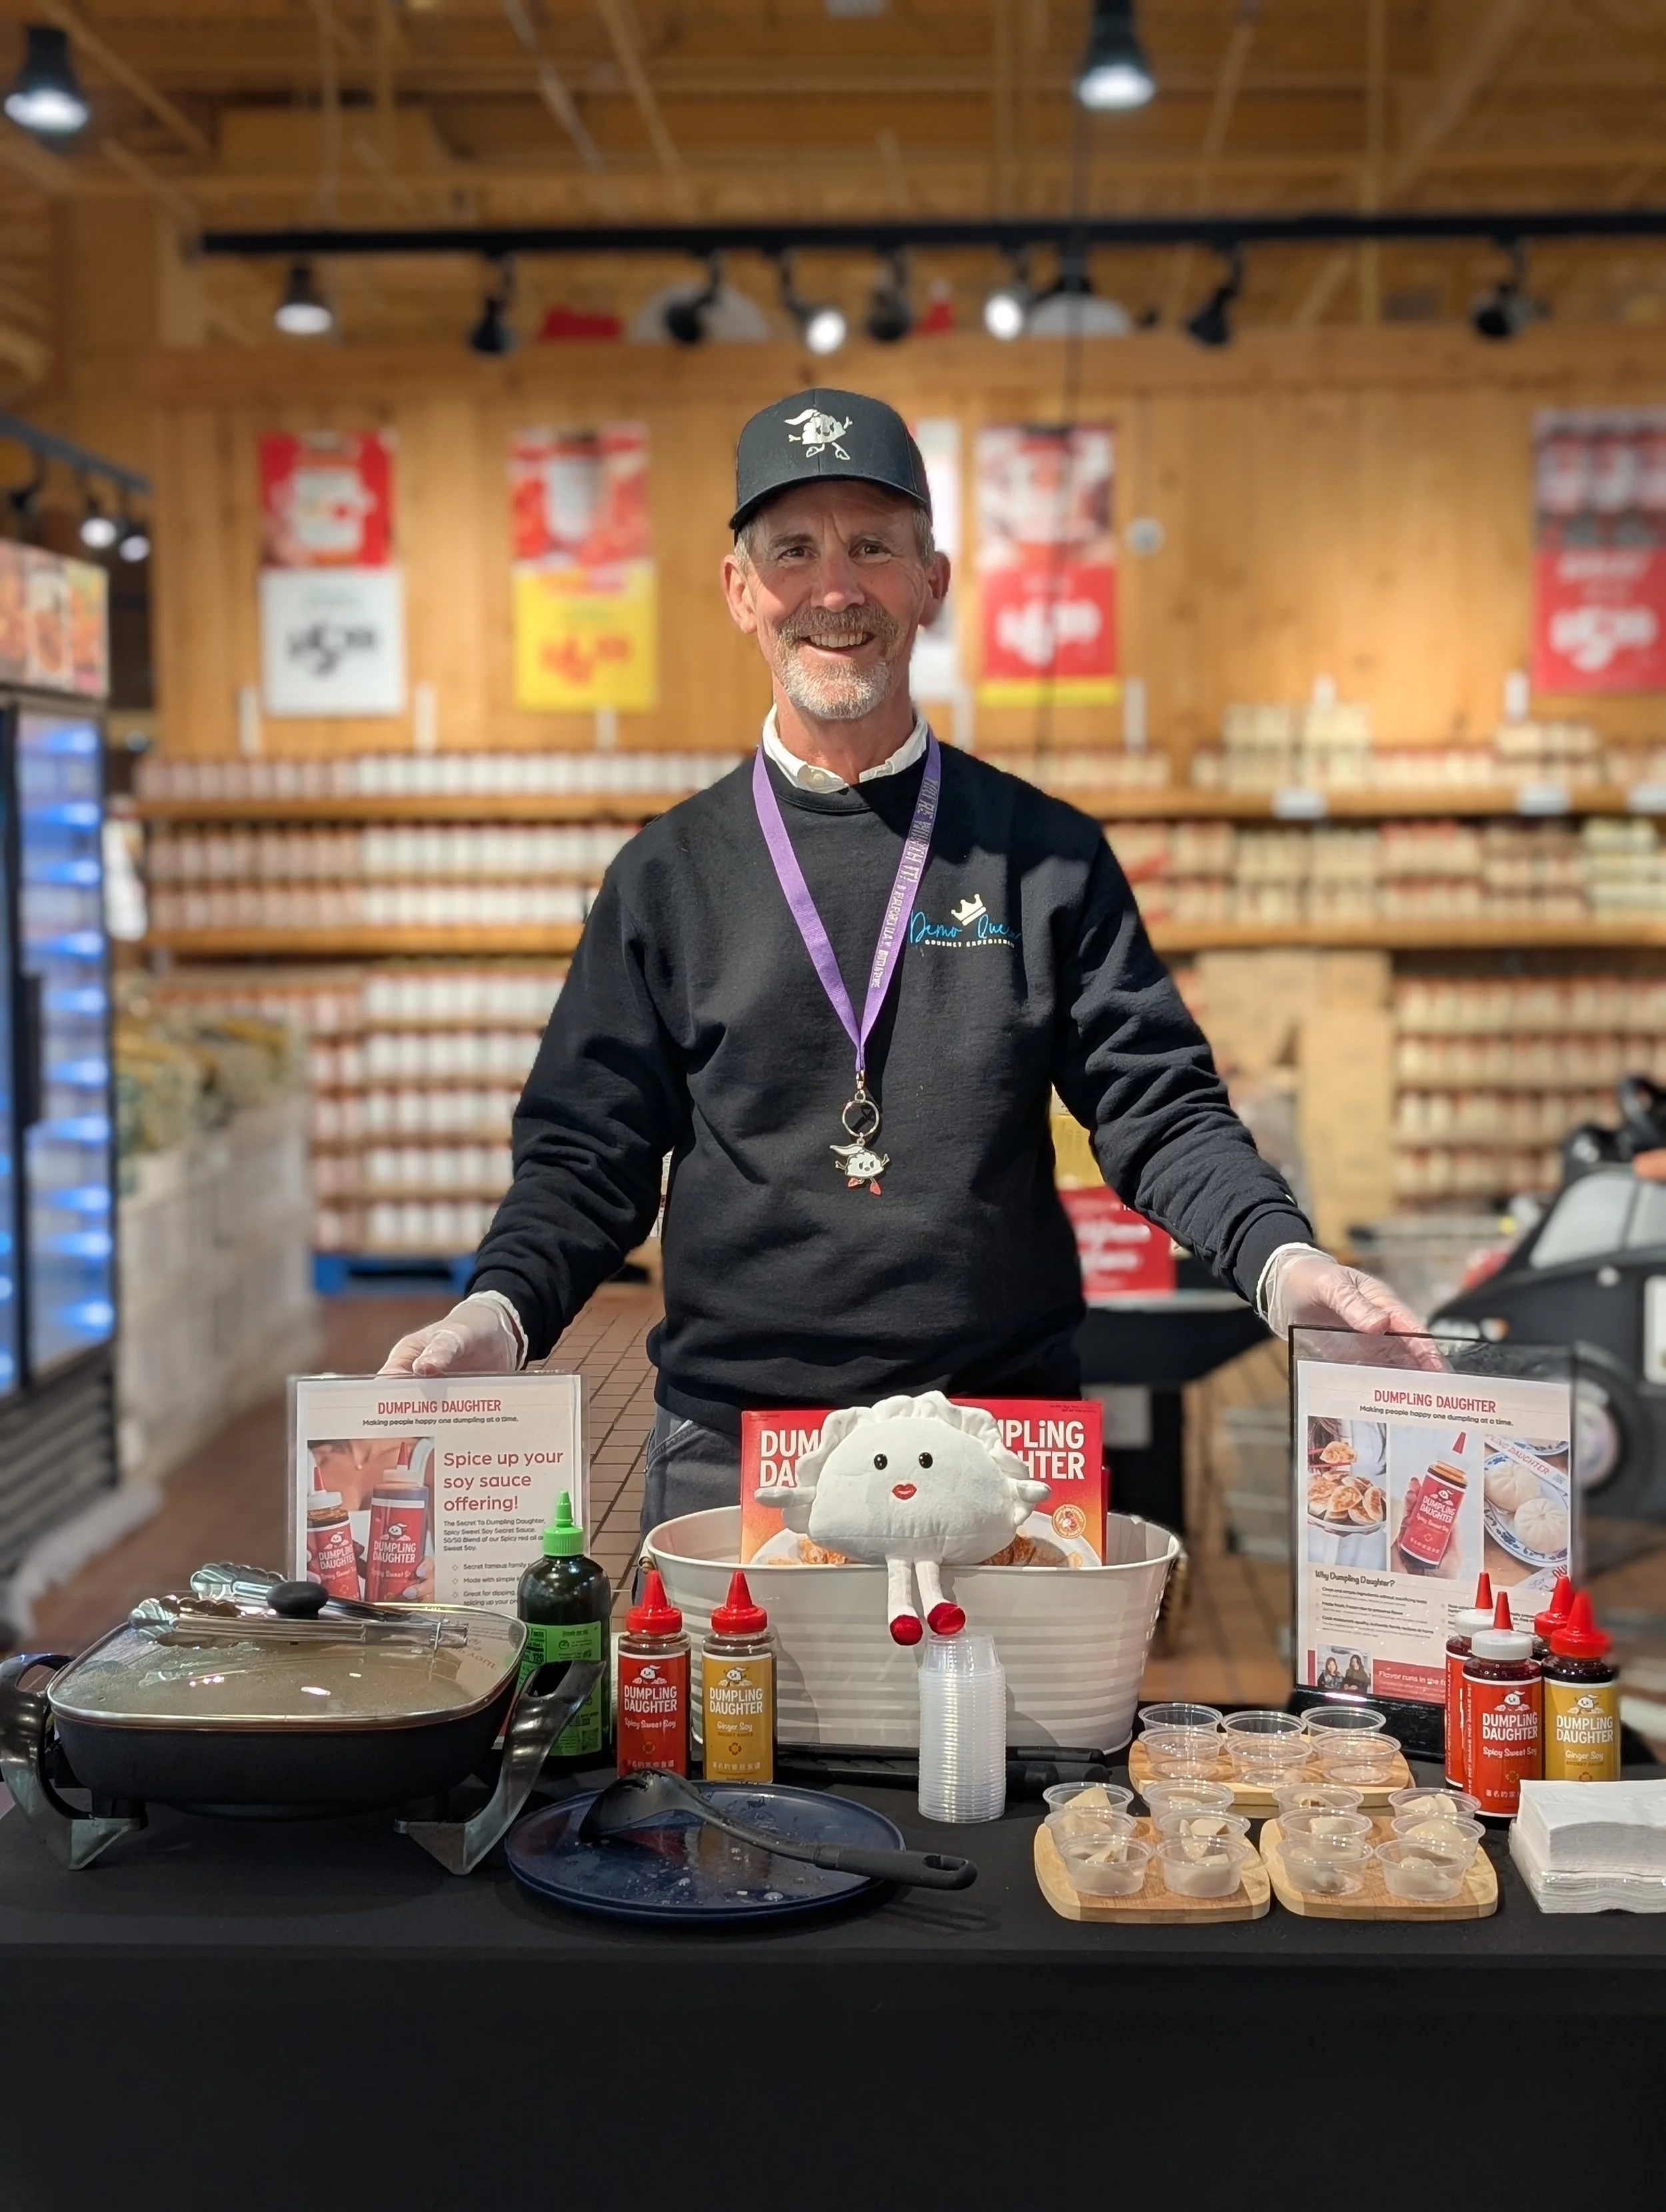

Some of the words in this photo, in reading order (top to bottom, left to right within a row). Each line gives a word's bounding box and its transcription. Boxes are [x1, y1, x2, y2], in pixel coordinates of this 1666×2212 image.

[910, 909, 962, 943] Demo
[978, 913, 1022, 939] Que
[442, 1399, 501, 1412] DAUGHTER
[1436, 1395, 1496, 1412] DAUGHTER
[1359, 1405, 1384, 1414] Making
[1410, 1410, 1431, 1418] happy
[1447, 1414, 1479, 1424] dumpling
[1496, 1418, 1513, 1426] time.
[761, 1429, 825, 1458] DUM
[444, 1452, 492, 1468] Spice
[498, 1454, 519, 1467] up
[524, 1452, 564, 1466] your
[444, 1476, 474, 1490] soy
[480, 1475, 532, 1488] sauce
[444, 1496, 518, 1512] offering!
[373, 1552, 416, 1564] DAUGHTER
[1315, 1570, 1329, 1580] Why
[1330, 1572, 1359, 1584] Dumpling
[1360, 1576, 1395, 1587] Daughter?
[1378, 1670, 1401, 1679] Flavor
[624, 1698, 678, 1714] DAUGHTER
[710, 1700, 763, 1715] DAUGHTER
[641, 1720, 662, 1728] Sweet
[717, 1721, 738, 1732] Ginger
[739, 1722, 752, 1732] Soy
[1483, 1726, 1538, 1741] DAUGHTER
[1556, 1729, 1613, 1744] DAUGHTER
[1483, 1746, 1503, 1758] Spicy
[1504, 1748, 1525, 1757] Sweet
[1527, 1747, 1537, 1756] Soy
[1565, 1750, 1589, 1762] Ginger
[1591, 1751, 1604, 1761] Soy
